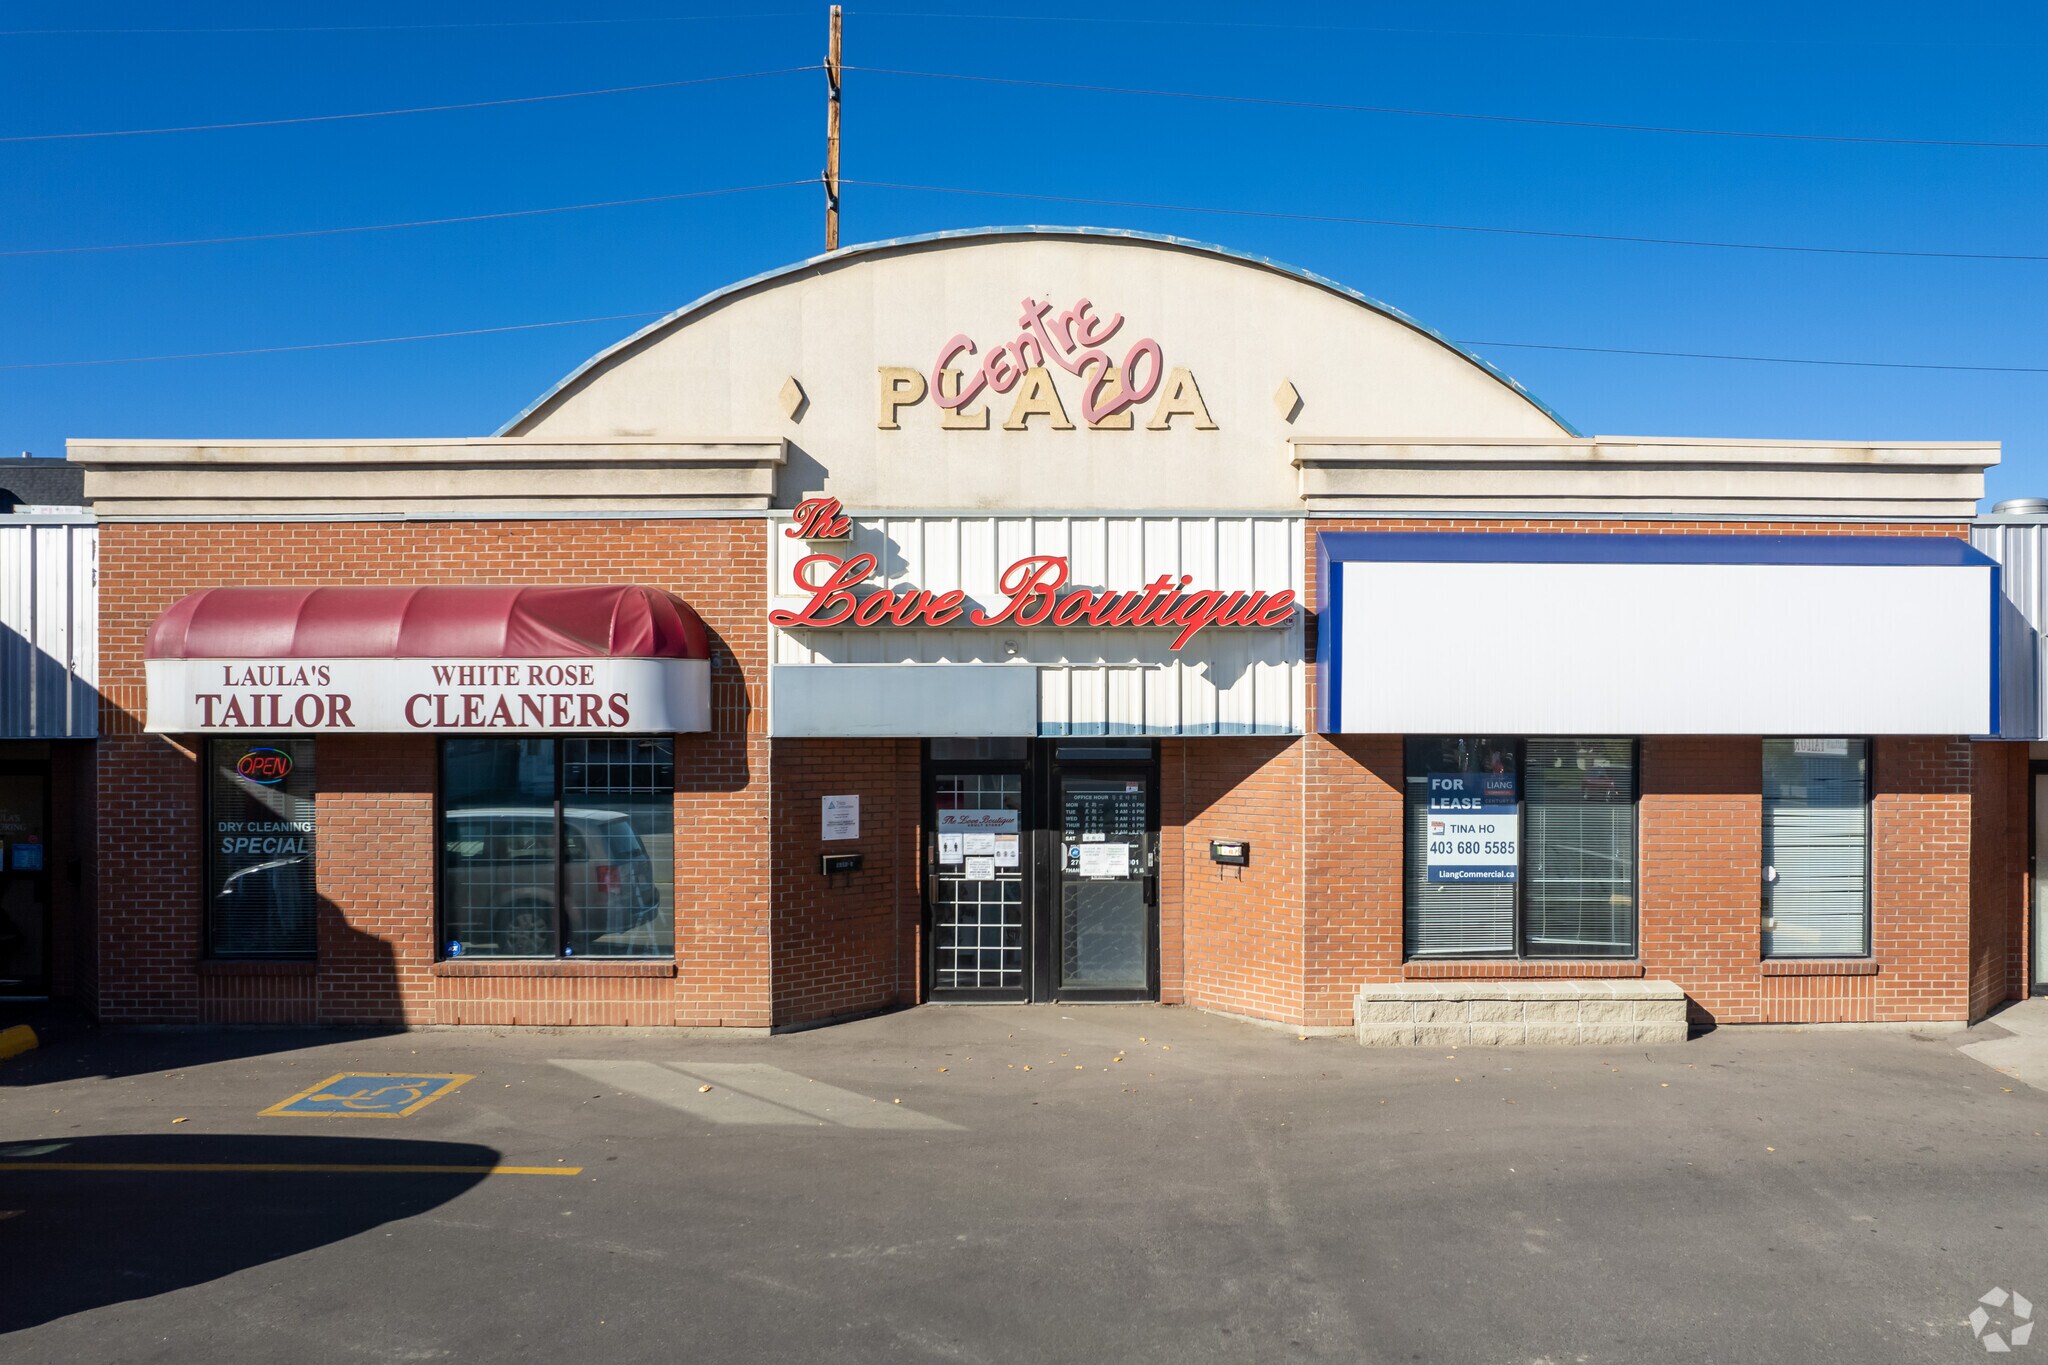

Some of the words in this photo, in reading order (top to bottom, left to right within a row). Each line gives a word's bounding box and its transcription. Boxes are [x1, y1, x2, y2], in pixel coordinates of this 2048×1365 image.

[931, 297, 1124, 409] Centre
[1074, 338, 1164, 425] 20
[878, 366, 1220, 431] PLAZA
[785, 495, 853, 539] The
[768, 552, 966, 627] Love
[969, 555, 1297, 652] Boutique
[223, 665, 331, 687] LAULA'S
[431, 665, 520, 686] WHITE
[527, 664, 595, 686] ROSE
[195, 693, 356, 728] TAILOR
[404, 692, 630, 728] CLEANERS
[240, 757, 287, 775] OPEN
[1432, 779, 1464, 790] FOR
[1486, 781, 1513, 789] LIANG
[1431, 797, 1482, 809] LEASE
[218, 822, 243, 832] DRY
[247, 822, 311, 832] CLEANING
[942, 815, 956, 824] The
[957, 815, 978, 824] Love
[980, 815, 1015, 825] Boutique
[1450, 824, 1476, 834] TINA
[1478, 824, 1495, 834] HO
[221, 837, 308, 854] SPECIAL
[1430, 841, 1453, 854] 403
[1457, 841, 1480, 854] 680
[1484, 841, 1515, 854] 5585
[1439, 870, 1515, 879] LiangCommercial.ca
